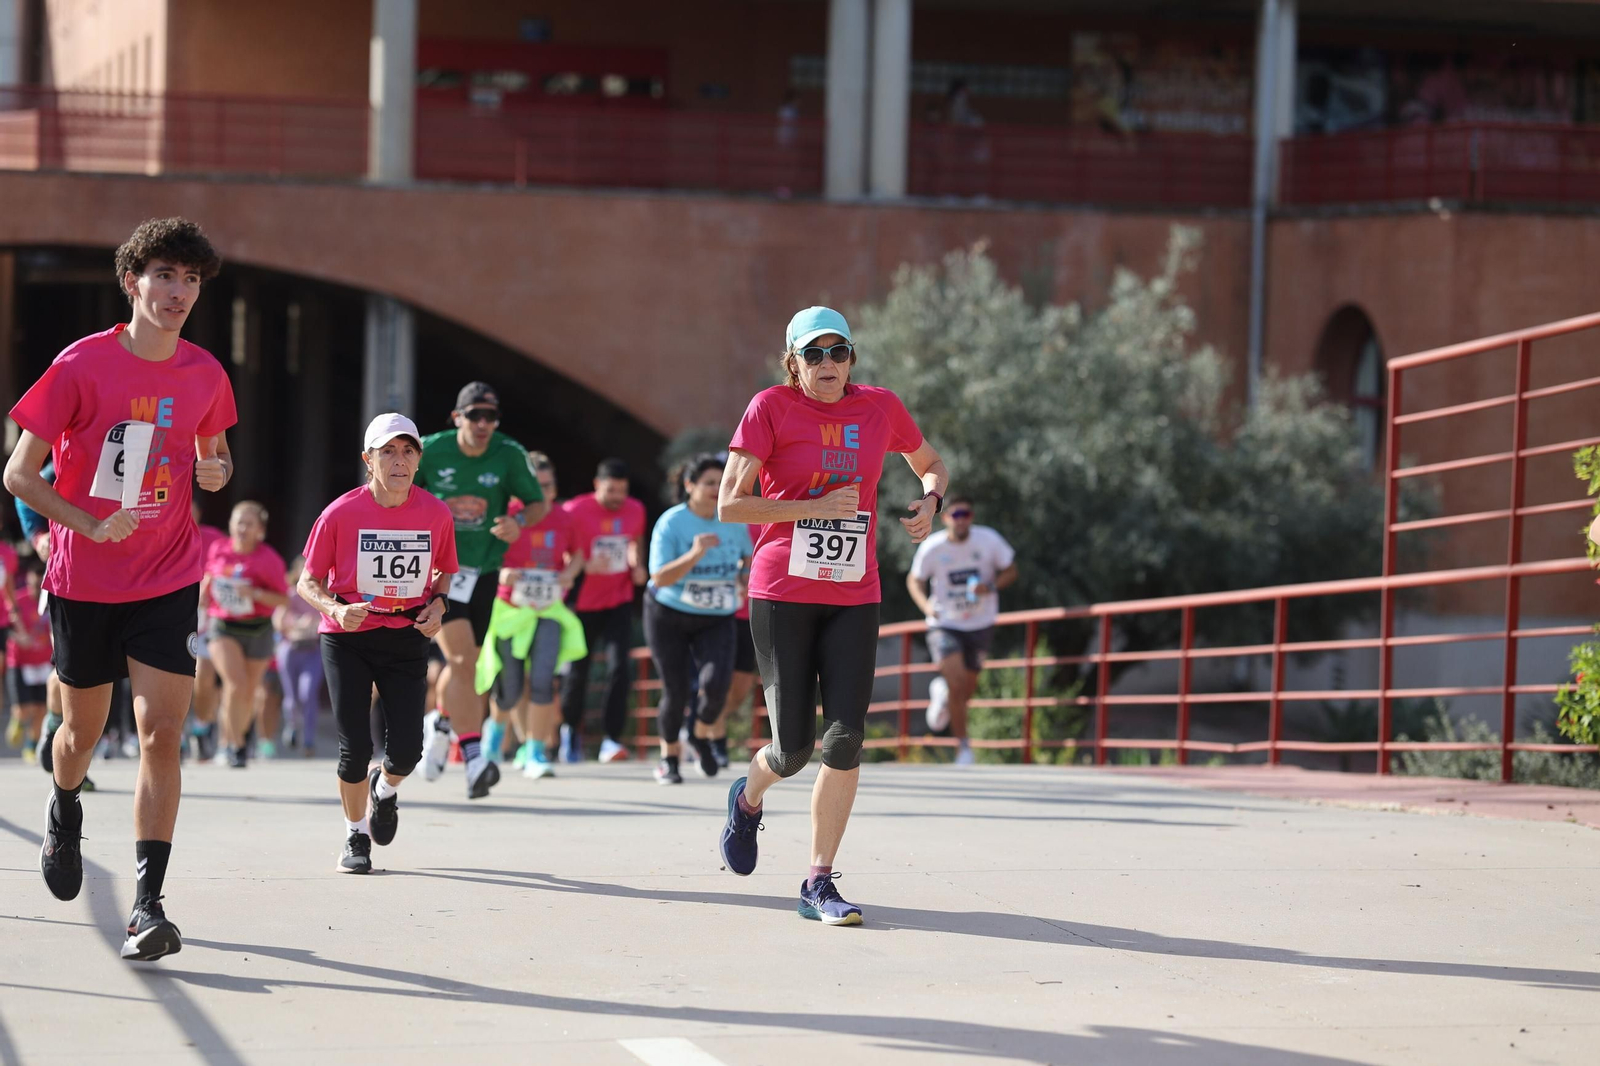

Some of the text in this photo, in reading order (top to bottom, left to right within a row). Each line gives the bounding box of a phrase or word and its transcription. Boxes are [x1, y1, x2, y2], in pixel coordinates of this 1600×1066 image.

[131, 396, 173, 428] WE
[819, 423, 860, 449] WE
[822, 449, 857, 472] RUN
[800, 517, 835, 530] UMA
[362, 541, 397, 551] UMA
[806, 533, 858, 562] 397
[372, 555, 421, 579] 164
[384, 587, 397, 595] WE
[452, 575, 466, 589] 2
